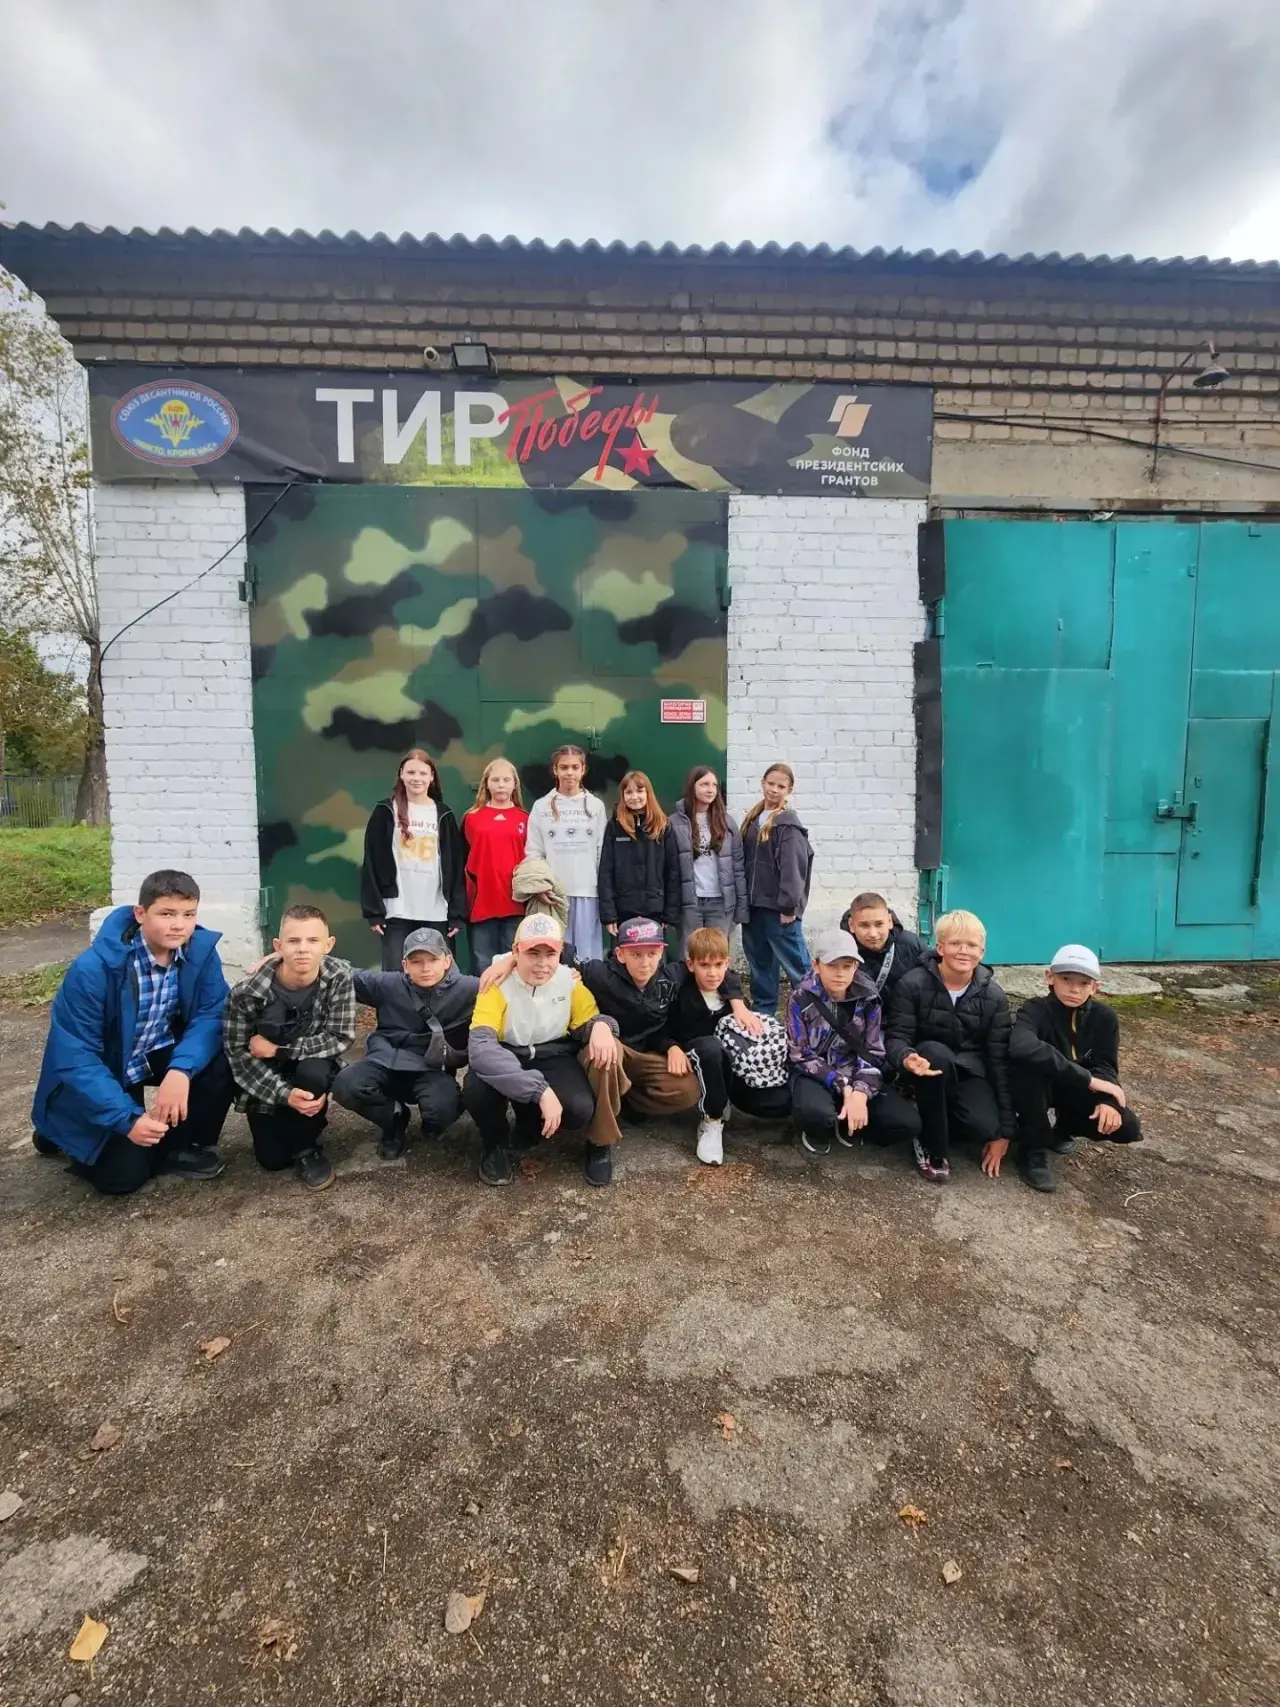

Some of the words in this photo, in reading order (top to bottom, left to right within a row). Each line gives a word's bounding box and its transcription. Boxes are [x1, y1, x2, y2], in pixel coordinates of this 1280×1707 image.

[119, 398, 140, 421] СОЮЗ
[140, 386, 202, 404] ДЕСАНТНИКОВ
[202, 396, 230, 425] РОССИИ
[315, 388, 510, 466] ТИР
[497, 386, 660, 481] Победы
[831, 446, 870, 458] ФОНД
[795, 460, 905, 473] ПРЕЗИДЕНТСКИХ
[821, 475, 879, 486] ГРАНТОВ
